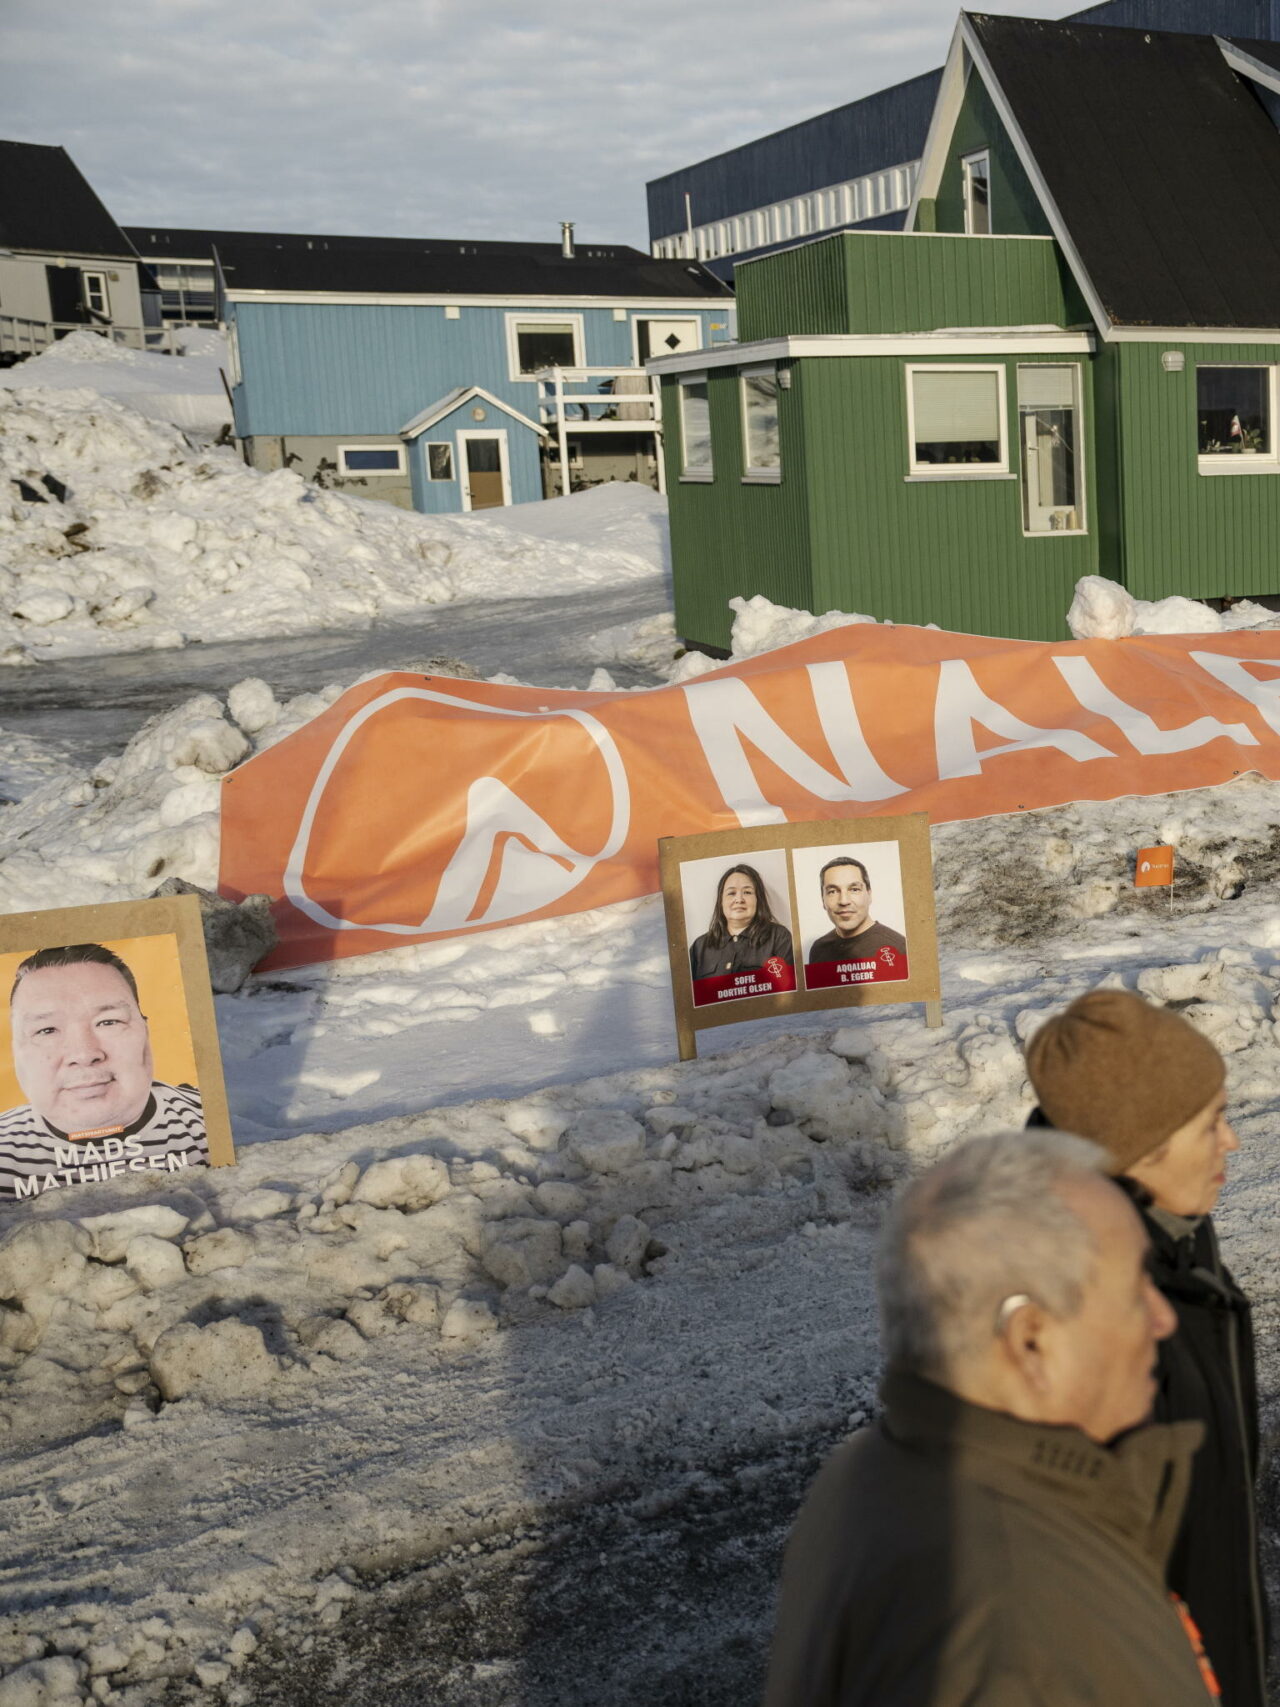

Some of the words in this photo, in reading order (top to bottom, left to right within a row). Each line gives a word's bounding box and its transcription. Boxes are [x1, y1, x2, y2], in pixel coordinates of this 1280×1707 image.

[836, 961, 877, 974] AQQALUAQ
[734, 974, 756, 985] SOFIE
[841, 973, 850, 983] B.
[850, 971, 875, 982] EGEDE
[717, 986, 748, 999] DORTHE
[749, 982, 773, 996] OLSEN
[54, 1134, 145, 1169] MADS
